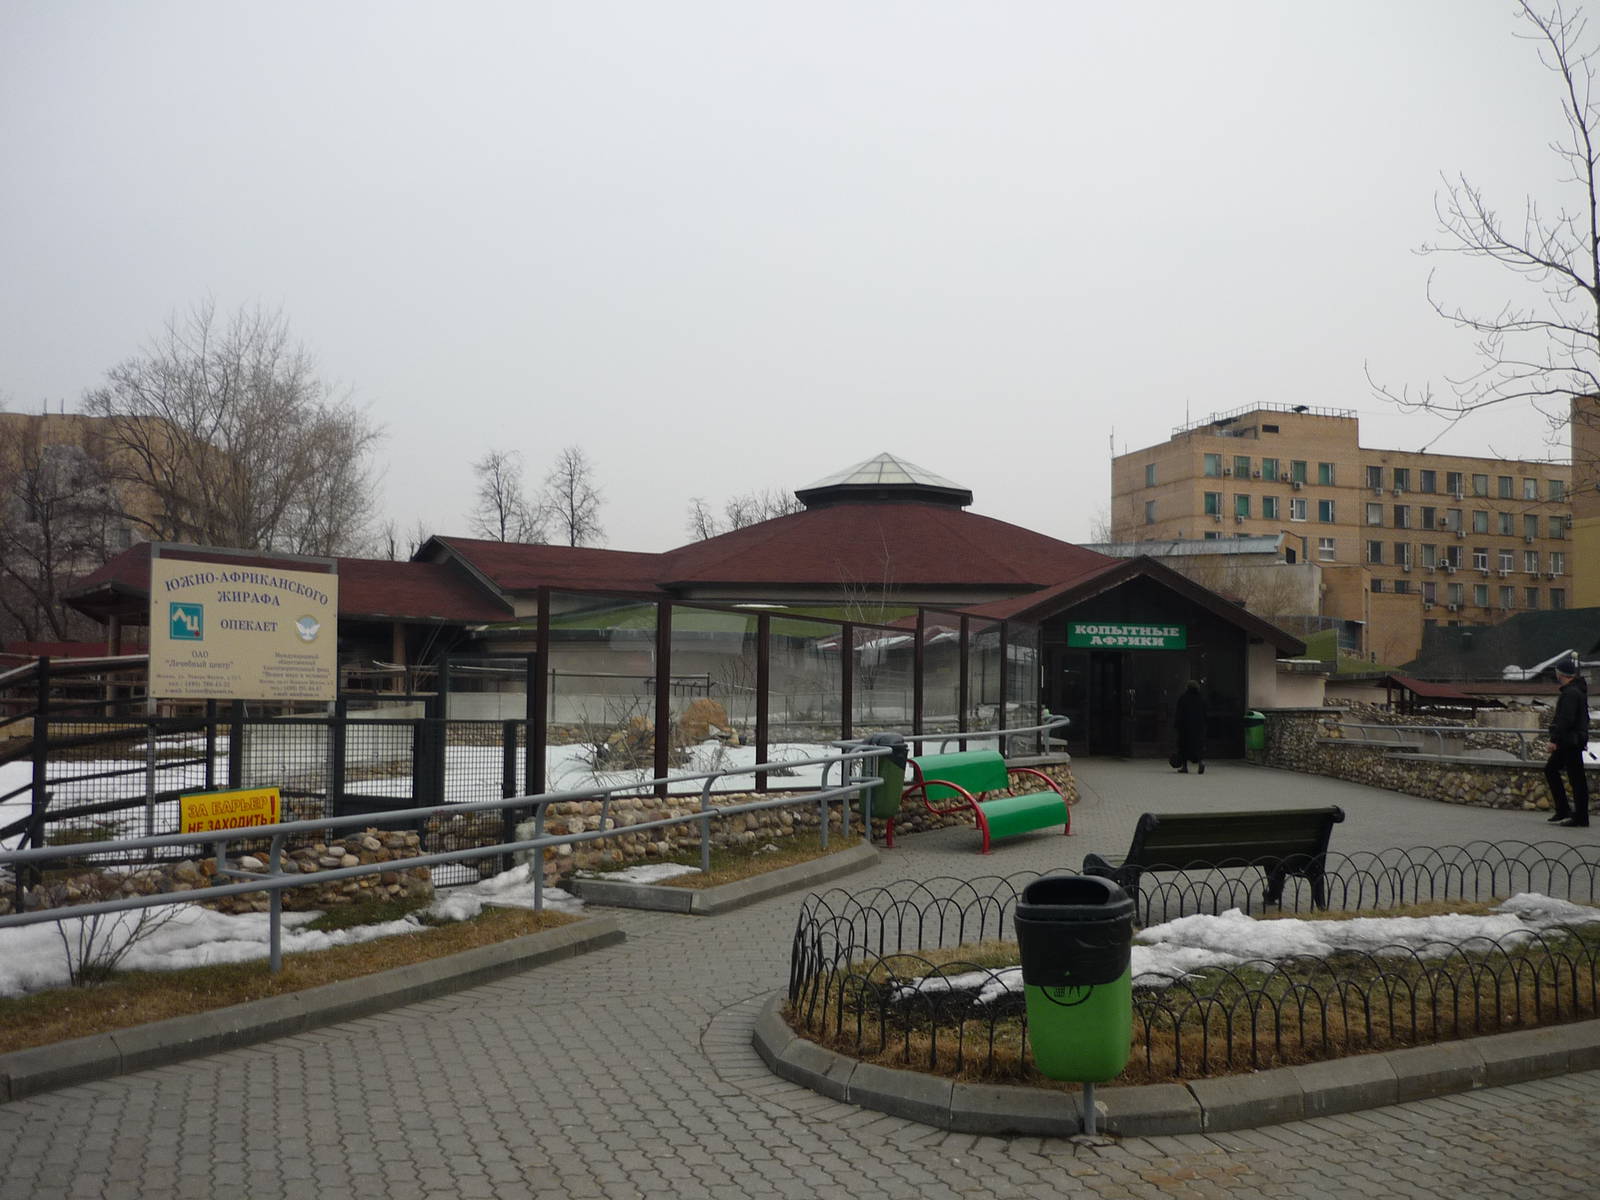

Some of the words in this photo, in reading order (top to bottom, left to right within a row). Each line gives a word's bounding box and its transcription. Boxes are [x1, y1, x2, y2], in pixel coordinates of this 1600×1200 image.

[164, 571, 328, 606] ЮЖНО-АФРИКАНСКОГО
[217, 591, 281, 606] ЖИРАФА
[220, 619, 278, 632] ОПЕКАЕТ
[1075, 625, 1180, 637] КОПЫТНЫЕ
[1090, 636, 1165, 647] АФРИКИ
[191, 650, 209, 659] ОАО
[188, 803, 208, 818] ЗА
[212, 796, 268, 815] БАРЬЕР
[188, 822, 203, 833] НЕ
